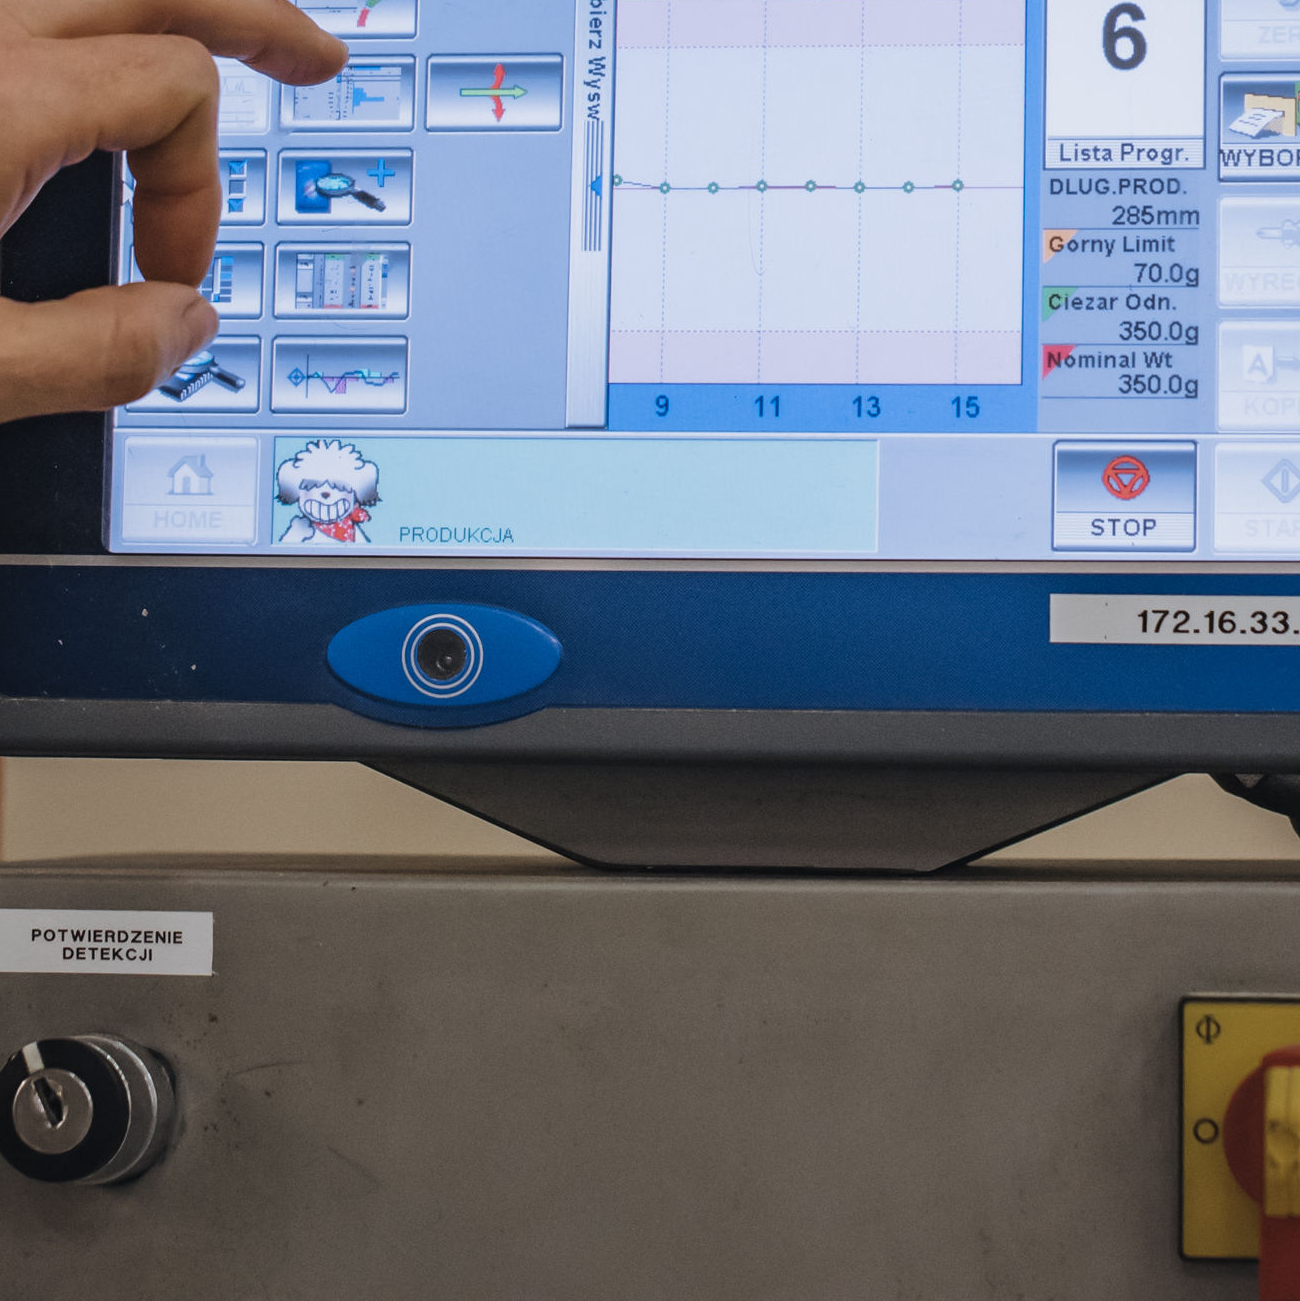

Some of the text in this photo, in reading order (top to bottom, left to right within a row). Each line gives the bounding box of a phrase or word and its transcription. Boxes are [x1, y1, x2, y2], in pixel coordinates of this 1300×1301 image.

[1102, 2, 1147, 70] 6
[1059, 143, 1189, 166] Lista Progr.
[1050, 178, 1188, 195] DLUG.PROD.
[1112, 206, 1200, 226] 285mm
[1049, 235, 1176, 257] Gorny Limit
[1134, 263, 1200, 287] 70.0g
[1048, 294, 1177, 311] Ciezar Odn.
[1119, 321, 1199, 345] 350.0g
[1047, 352, 1173, 369] Nominal Wt
[1118, 375, 1198, 398] 350.0g
[655, 396, 980, 418] 9 11 13 15
[154, 510, 223, 529] HOME
[1091, 519, 1157, 537] STOP
[400, 527, 514, 544] PRODUKCJA
[31, 929, 183, 944] POTWIERDZENIE
[62, 947, 153, 961] DETEKCJI
